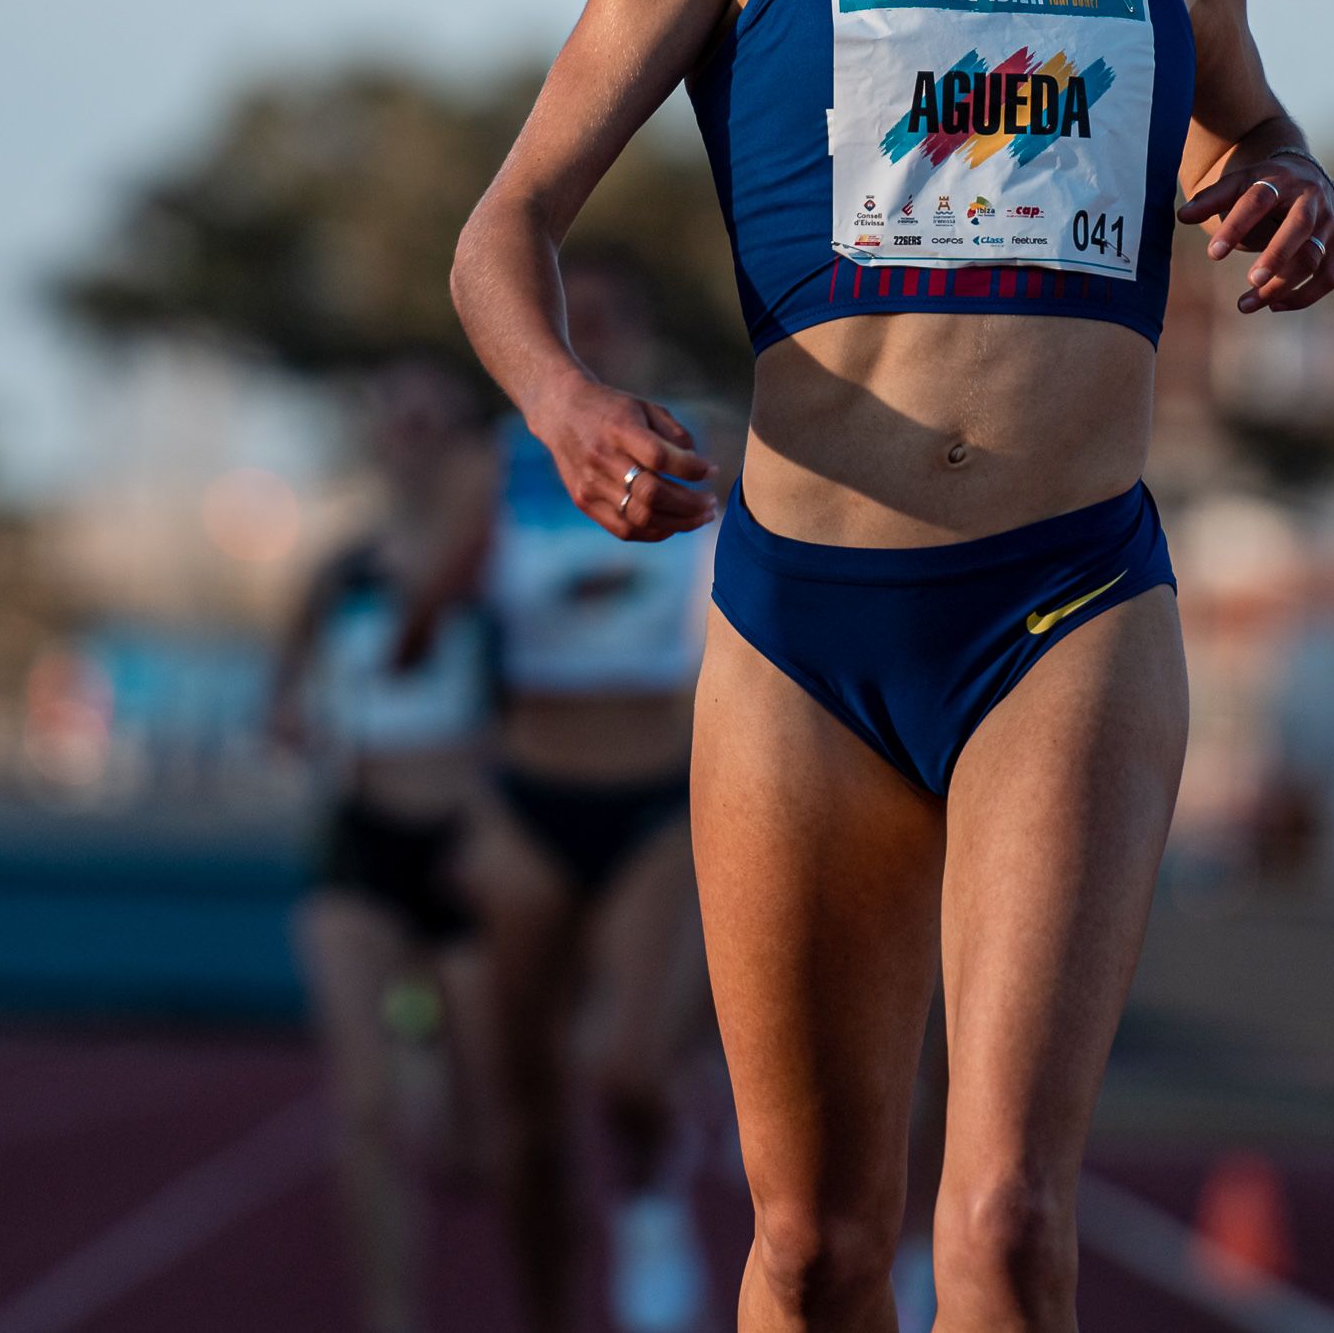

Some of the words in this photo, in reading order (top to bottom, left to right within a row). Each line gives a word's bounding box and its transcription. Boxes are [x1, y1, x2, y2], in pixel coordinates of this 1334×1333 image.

[907, 70, 1091, 138] AGUEDA
[1015, 206, 1041, 219] cap
[1073, 209, 1124, 258] 041
[893, 235, 923, 246] 226ERS
[931, 237, 964, 245] OOFOS
[1011, 235, 1048, 245] feetures
